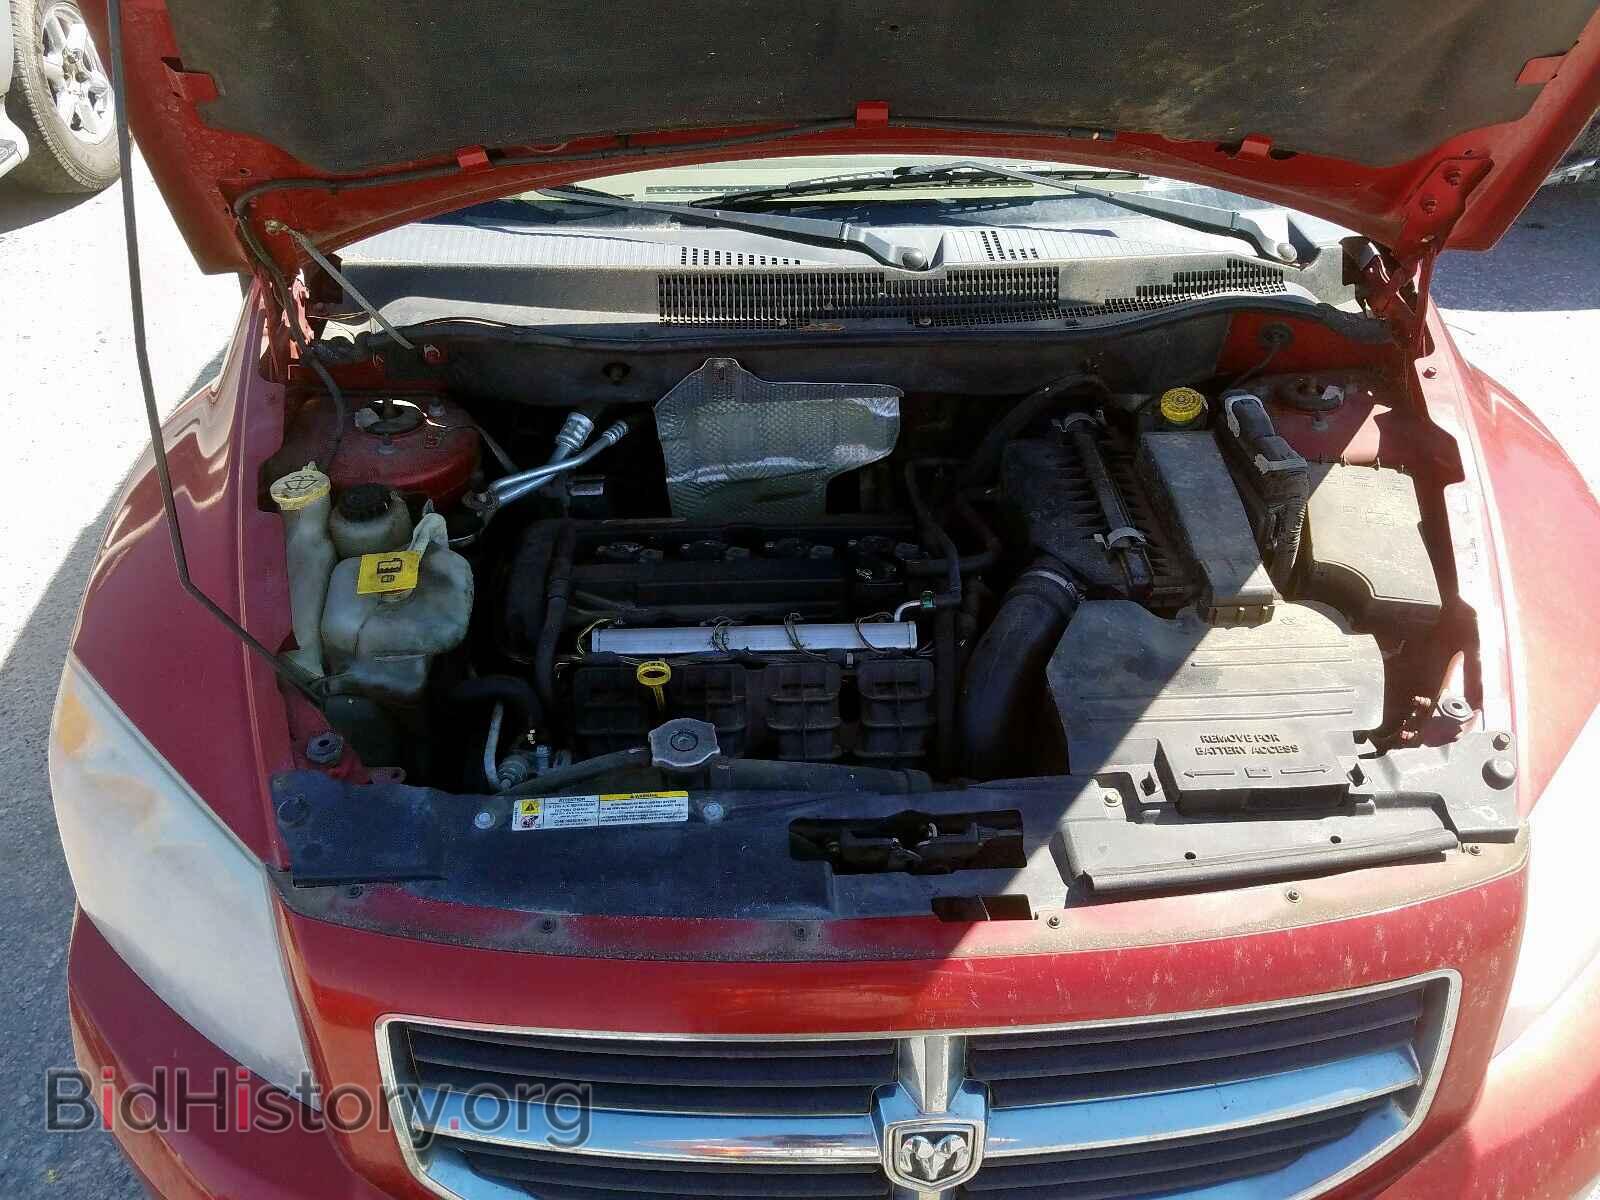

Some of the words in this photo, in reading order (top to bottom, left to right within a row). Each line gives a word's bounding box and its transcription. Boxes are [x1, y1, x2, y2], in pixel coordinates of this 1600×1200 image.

[1199, 733, 1253, 744] REMOVE
[1254, 733, 1281, 743] FOR
[1194, 745, 1247, 756] BATTERY
[1251, 744, 1300, 755] ACCESS
